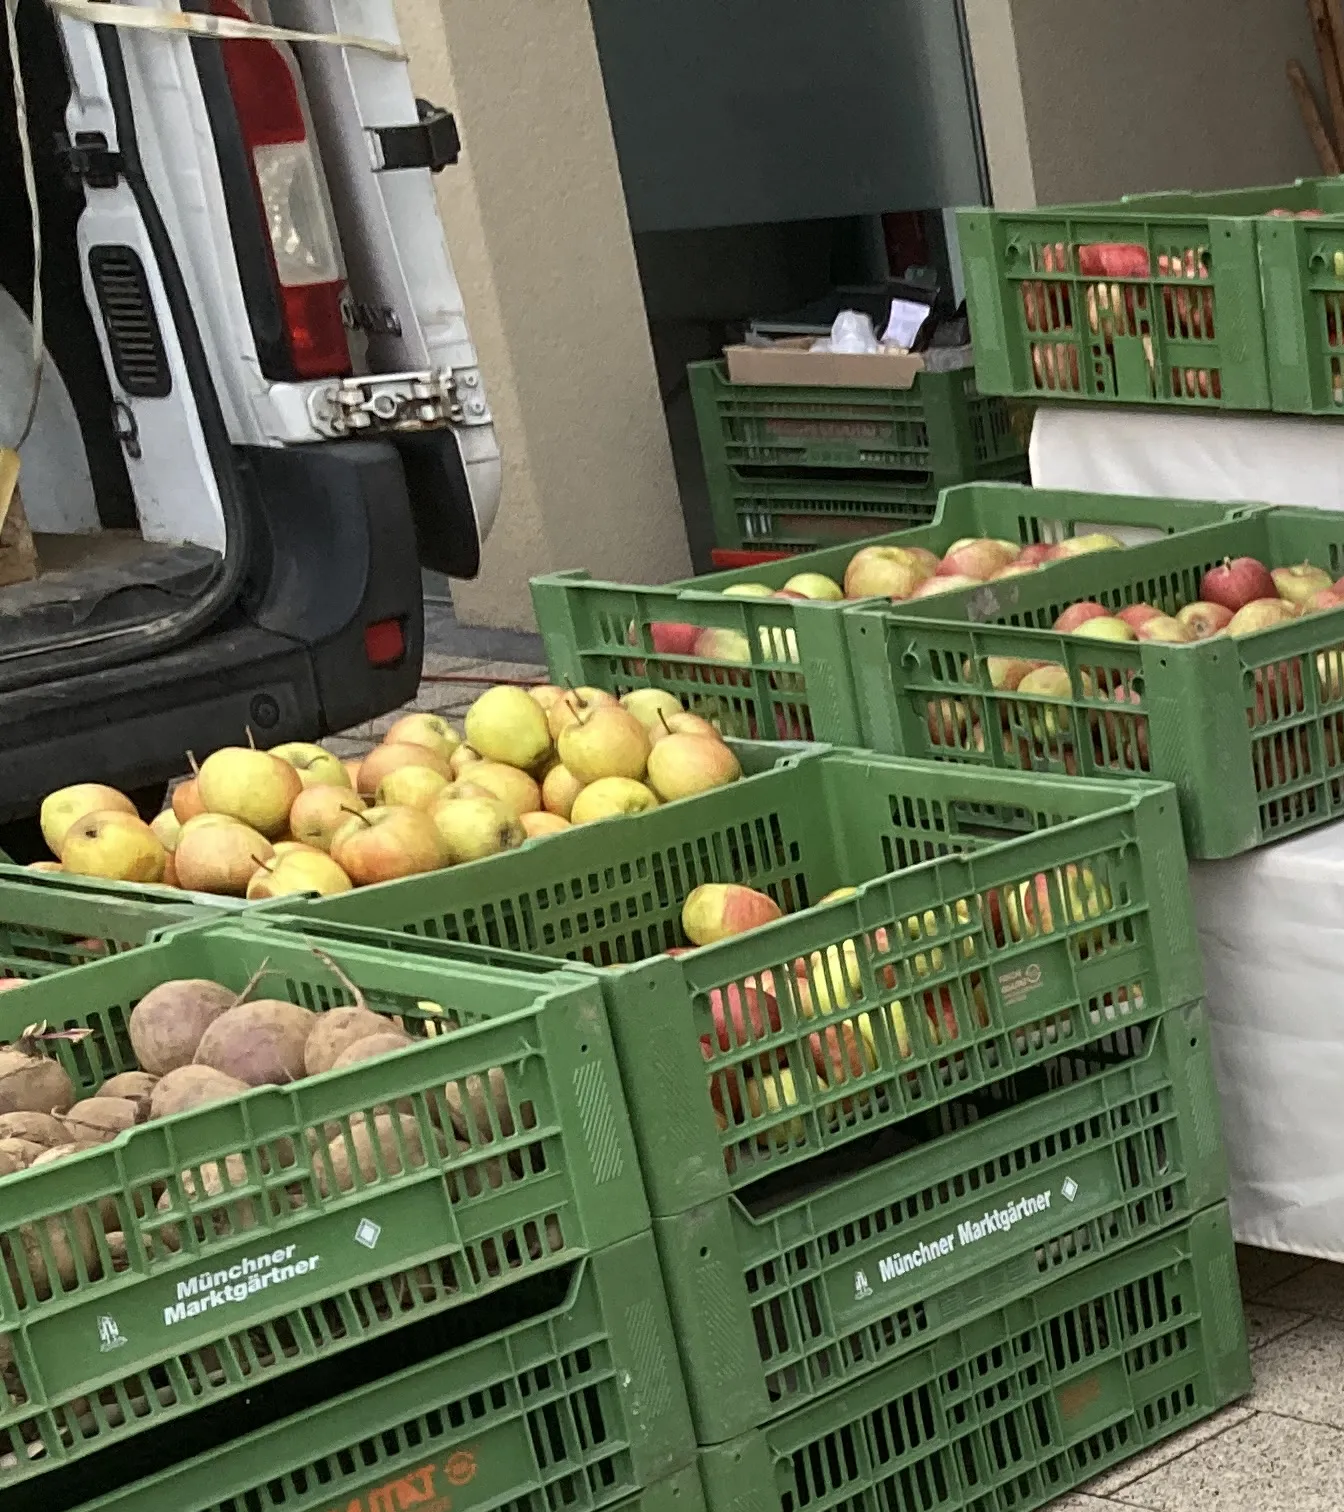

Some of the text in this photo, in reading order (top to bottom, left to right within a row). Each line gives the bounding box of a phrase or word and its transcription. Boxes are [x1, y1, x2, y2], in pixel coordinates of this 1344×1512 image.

[878, 1189, 1052, 1283] Münchner Marktgärtner
[163, 1255, 321, 1326] Marktgärtner
[177, 1243, 297, 1301] Münchner
